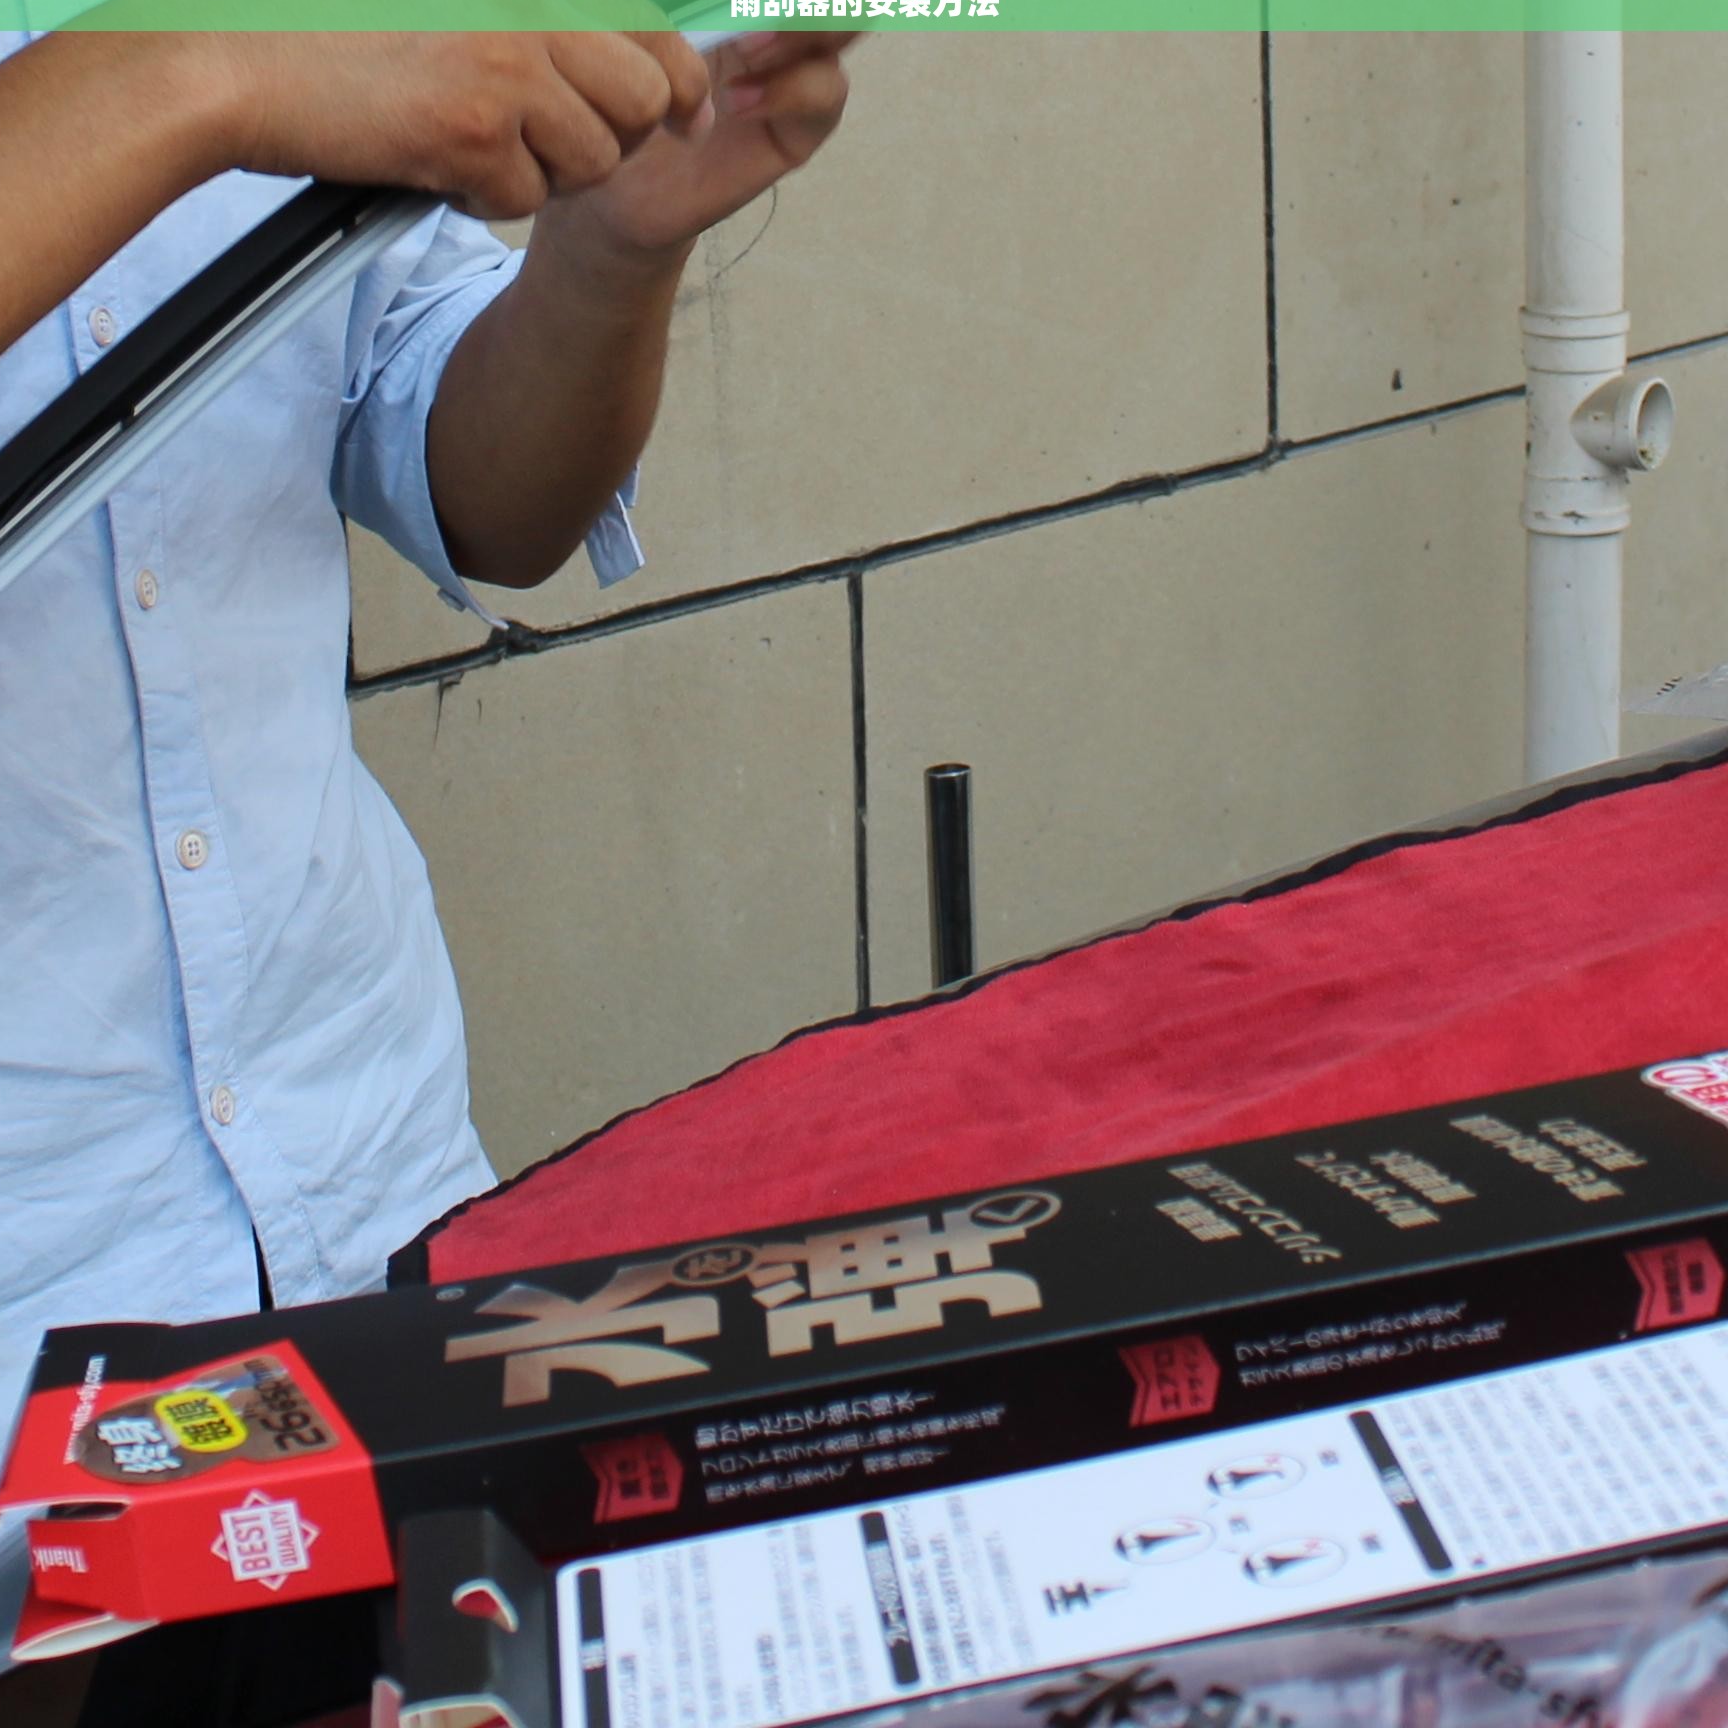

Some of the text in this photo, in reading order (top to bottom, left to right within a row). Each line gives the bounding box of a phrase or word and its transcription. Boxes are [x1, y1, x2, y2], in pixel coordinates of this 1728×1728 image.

[33, 1546, 87, 1573] Thank
[230, 1512, 272, 1574] BEST
[270, 1508, 299, 1567] QUALITY
